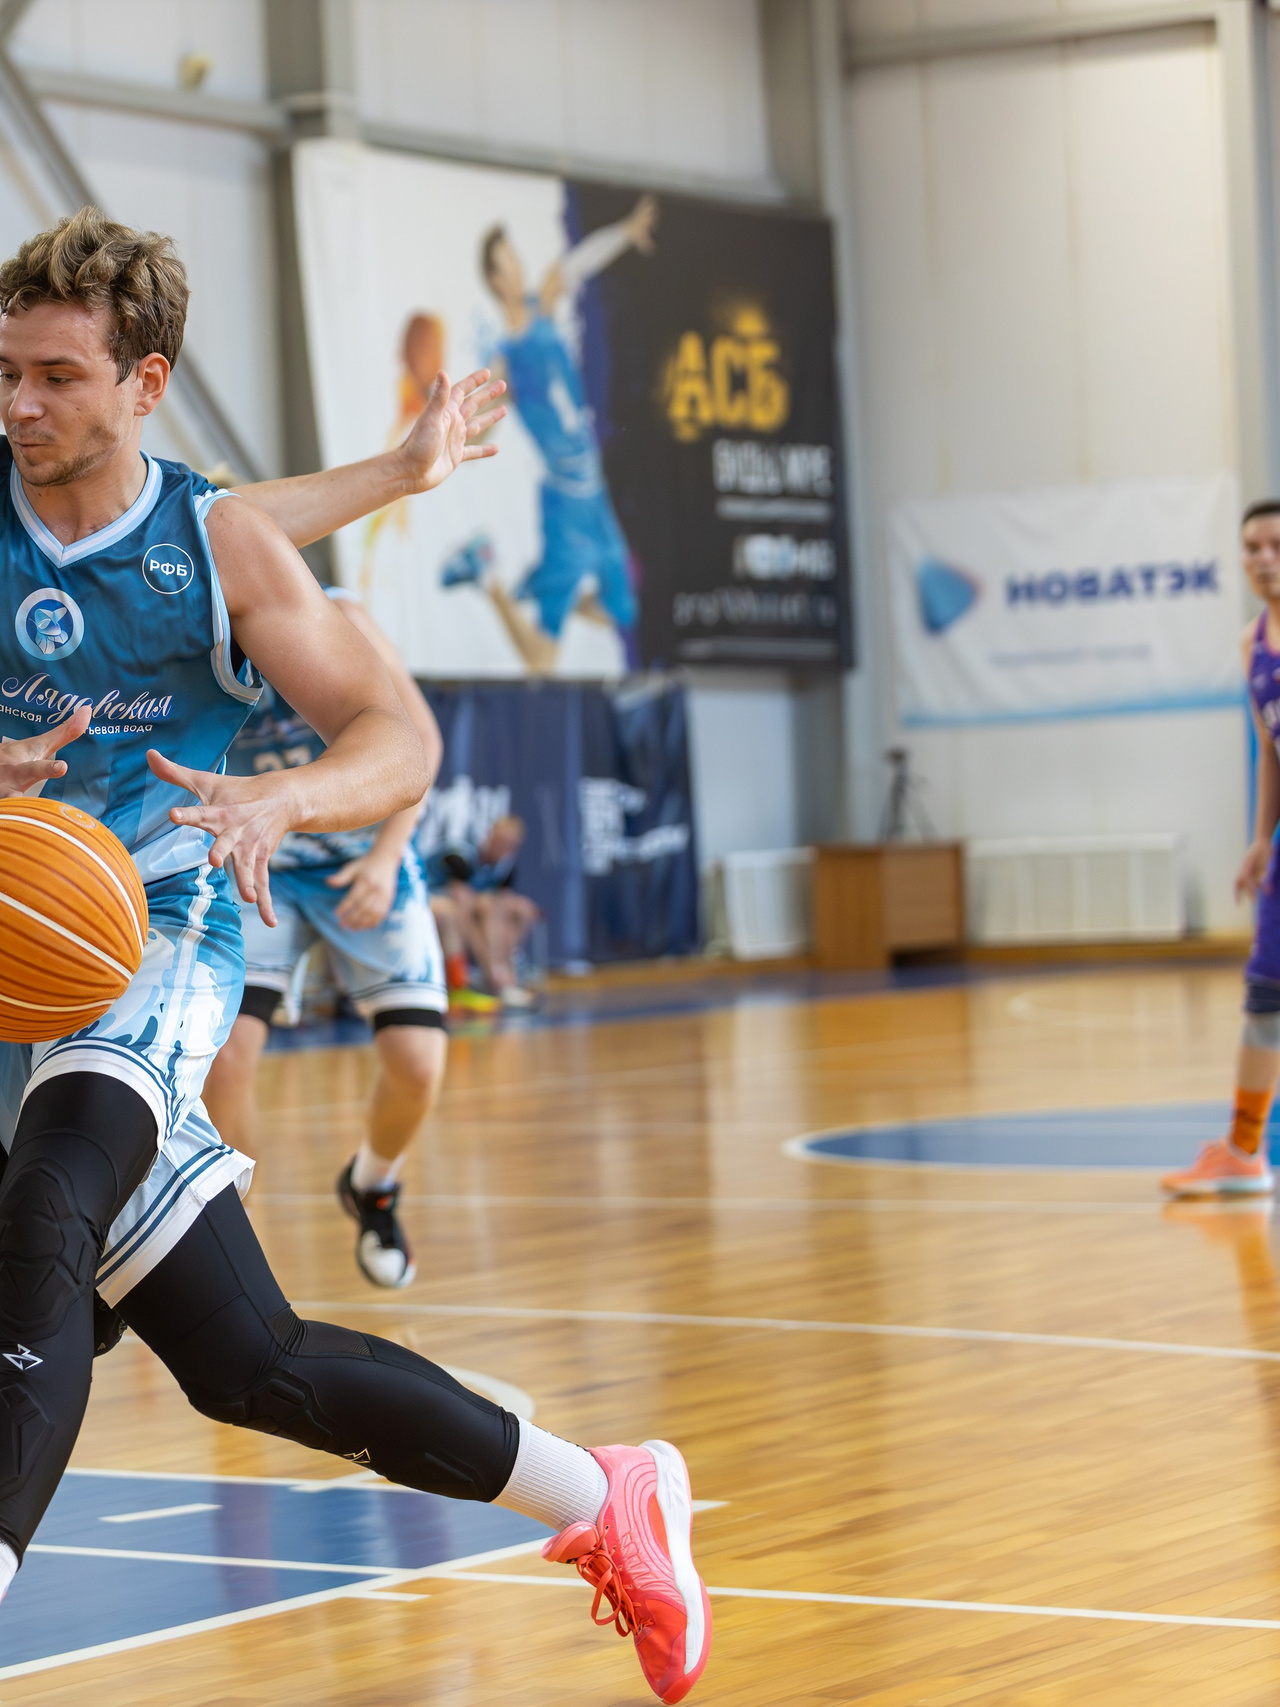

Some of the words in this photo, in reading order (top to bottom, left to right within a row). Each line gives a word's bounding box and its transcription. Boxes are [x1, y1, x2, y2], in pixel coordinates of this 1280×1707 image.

[150, 559, 187, 577] РФБ
[1006, 559, 1220, 609] НОВАТЭК
[123, 724, 154, 733] вода
